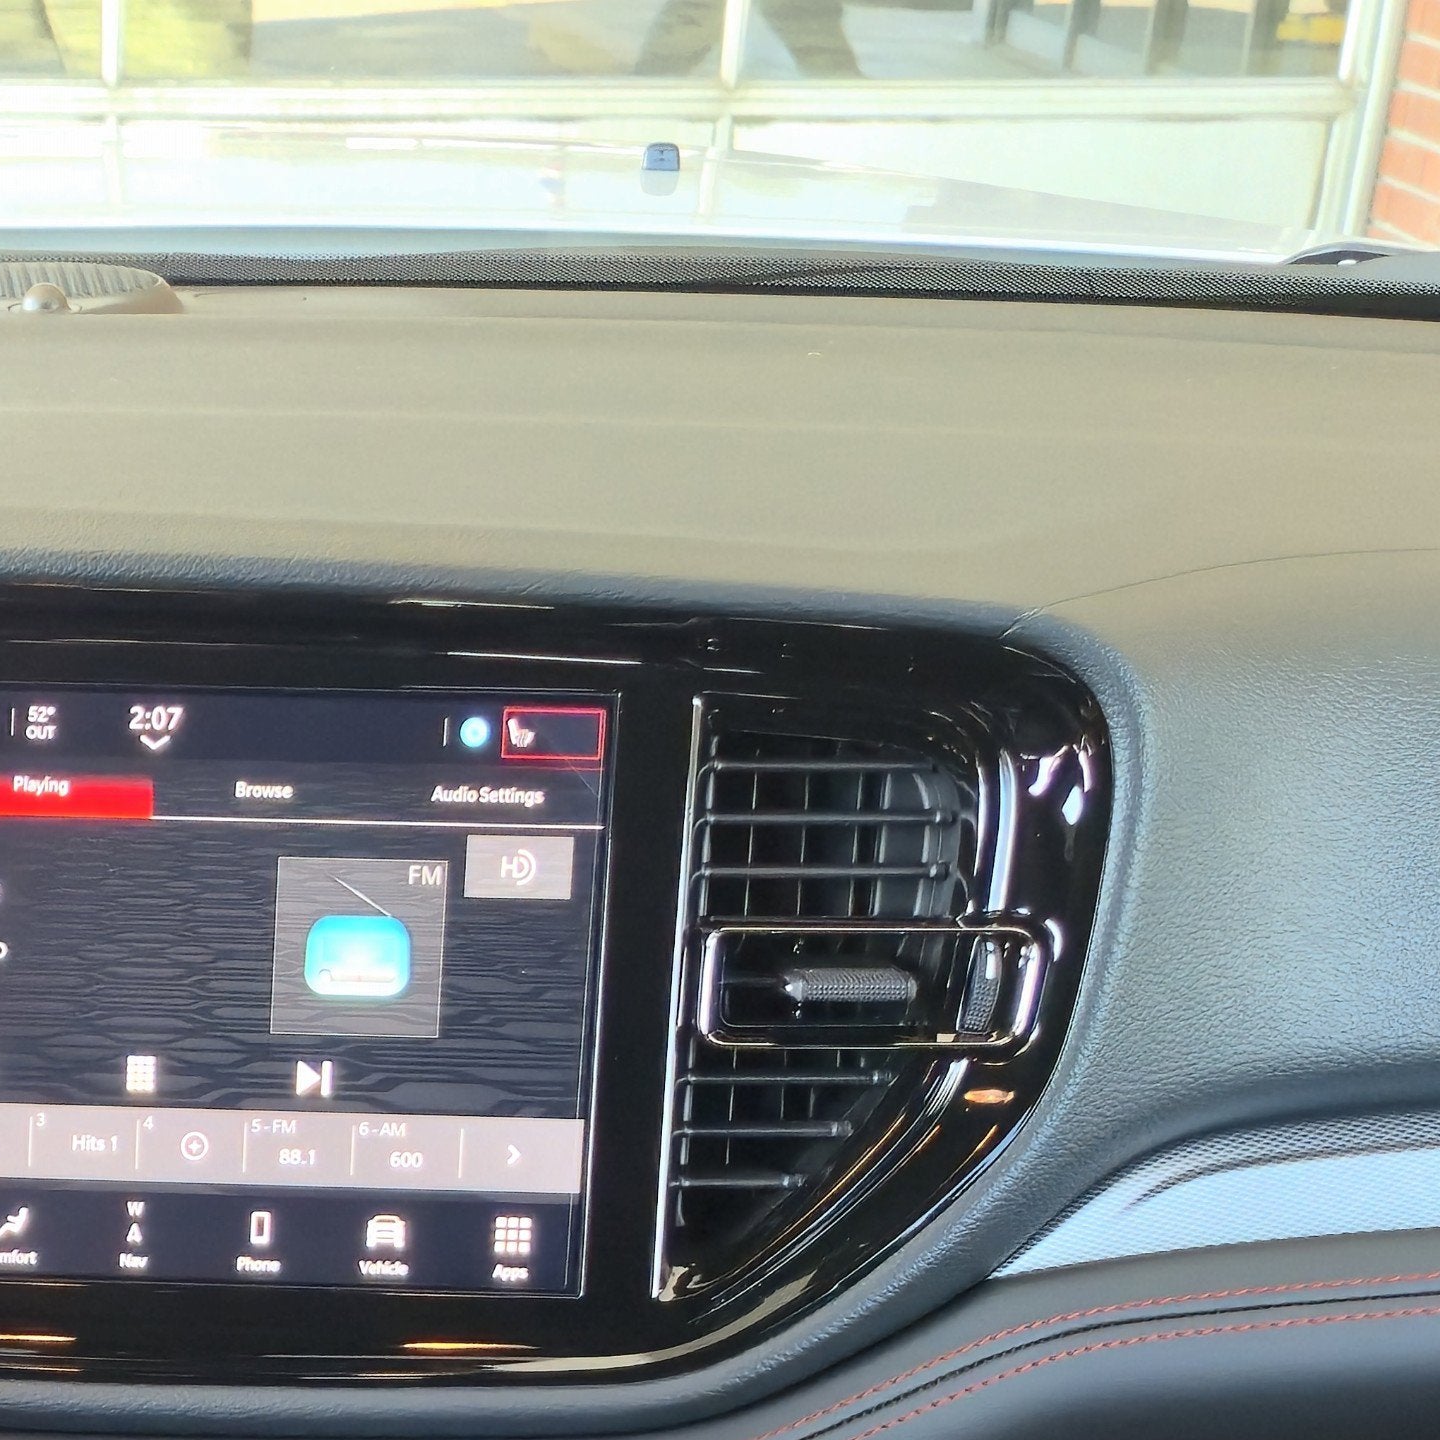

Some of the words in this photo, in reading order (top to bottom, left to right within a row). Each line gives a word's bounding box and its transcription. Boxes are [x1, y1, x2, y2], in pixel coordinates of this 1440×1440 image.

[27, 704, 58, 723] 52°
[129, 704, 185, 731] 2:07
[25, 724, 57, 741] OUT
[13, 774, 70, 797] Playing
[234, 780, 295, 800] Browse
[431, 784, 478, 804] Audio
[479, 785, 545, 808] Settings
[408, 864, 442, 886] FM
[36, 1113, 46, 1128] 3
[72, 1134, 105, 1153] Hits
[278, 1147, 316, 1166] 88.1
[390, 1151, 423, 1169] 600
[119, 1253, 149, 1270] Nav
[236, 1255, 282, 1274] Phone
[359, 1259, 409, 1277] Vehicle
[492, 1263, 529, 1282] Apps
